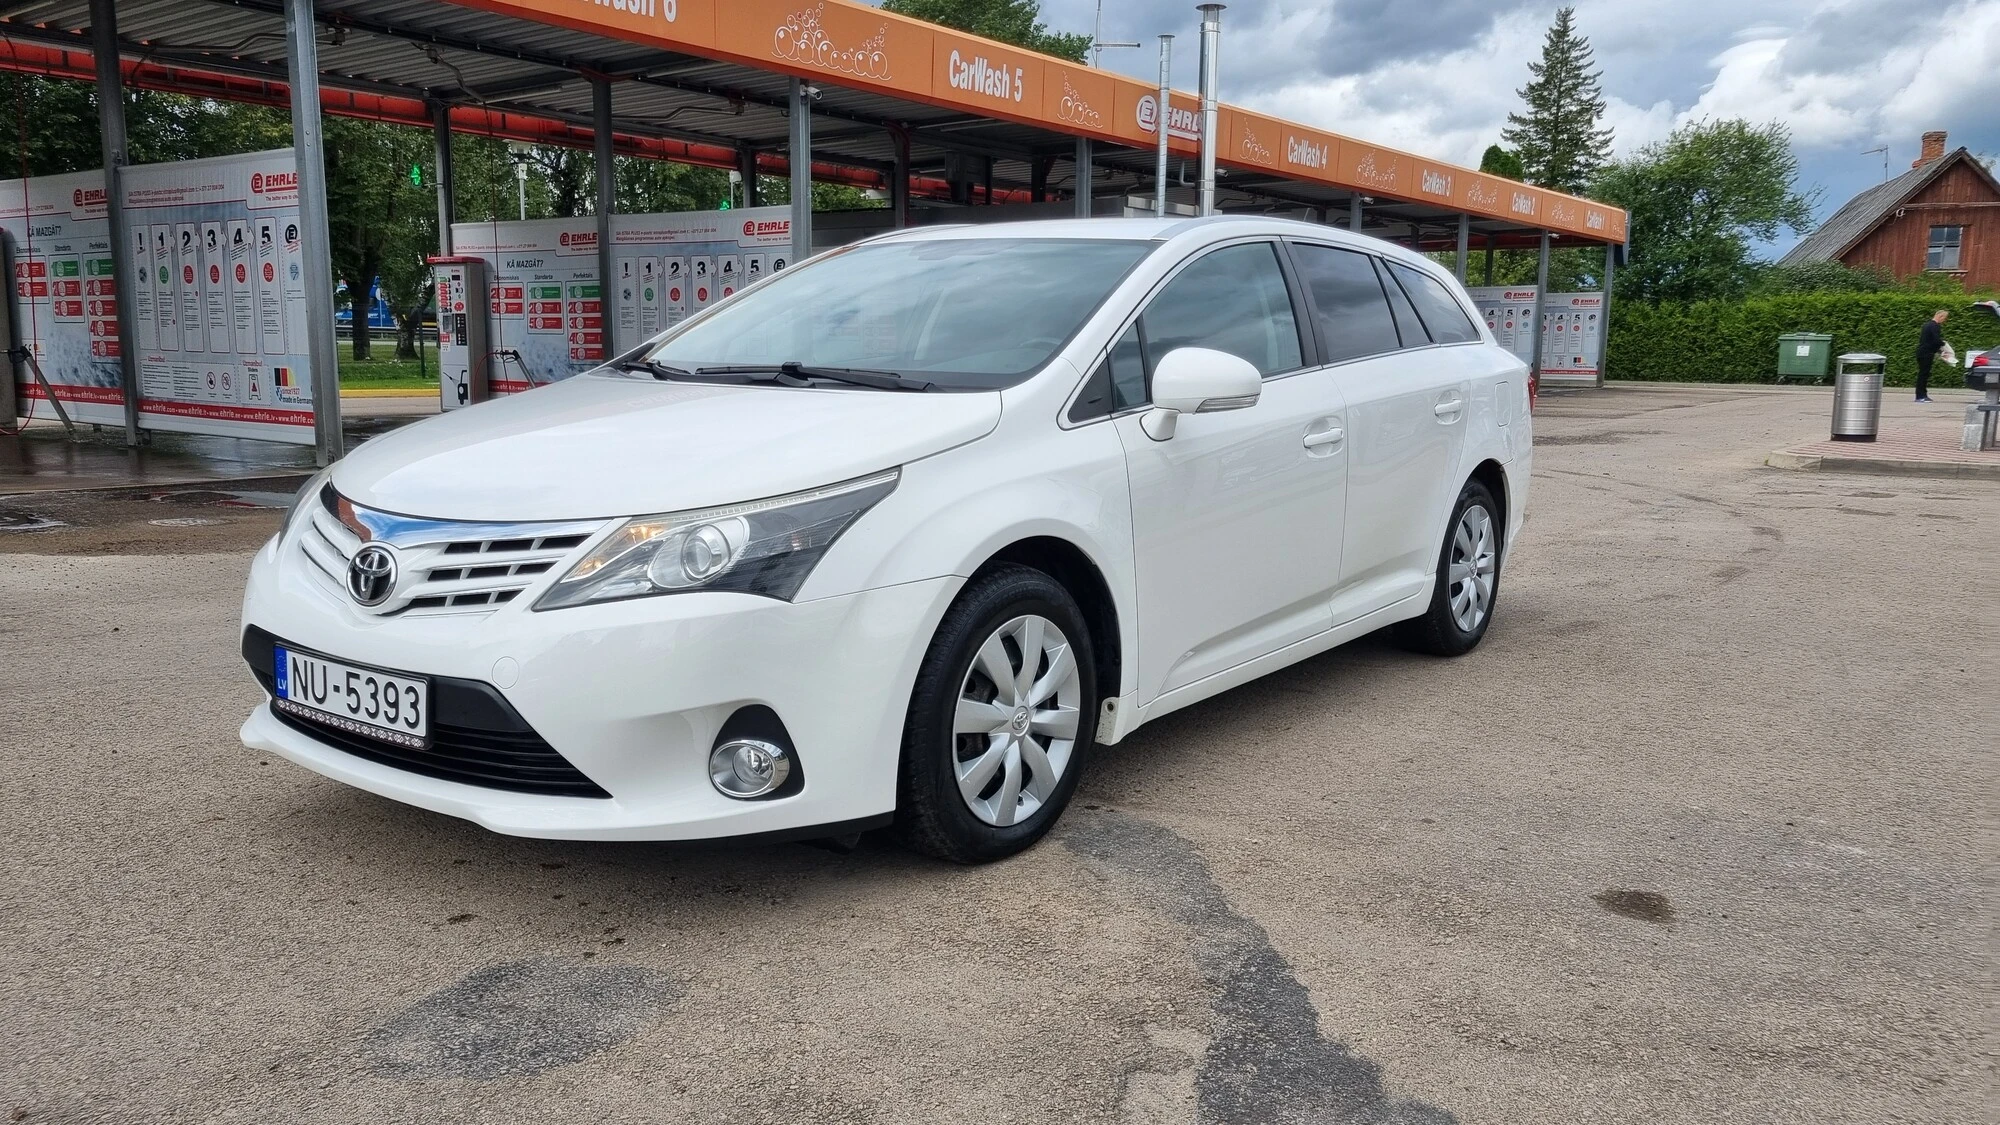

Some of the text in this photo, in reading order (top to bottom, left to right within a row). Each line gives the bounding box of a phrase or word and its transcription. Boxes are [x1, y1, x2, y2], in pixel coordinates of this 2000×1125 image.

[950, 50, 1022, 102] CarWash 5
[1288, 136, 1328, 170] CarWash 4
[266, 172, 298, 187] EHRLE
[1422, 169, 1451, 197] CarWash 3
[1512, 192, 1536, 216] CarWash 2
[757, 220, 790, 231] EHRLE
[1586, 209, 1602, 230] CarWash
[36, 224, 61, 237] MAZGĀT?
[234, 228, 243, 244] 4
[262, 226, 271, 244] 5
[571, 232, 597, 242] EHRLE
[158, 232, 164, 246] 1
[182, 231, 190, 247] 2
[207, 229, 216, 247] 3
[507, 258, 544, 268] KĀ MAZGĀT?
[646, 262, 651, 273] 1
[670, 262, 680, 274] 2
[697, 261, 706, 274] 3
[724, 260, 732, 273] 4
[750, 260, 760, 273] 5
[491, 289, 496, 298] 2
[492, 304, 496, 313] 5
[568, 303, 573, 312] 2
[569, 318, 574, 328] 3
[143, 404, 175, 412] www.ehrle.com
[243, 412, 275, 420] www.ehrle.lv
[278, 414, 313, 424] www.ehrle.co
[277, 678, 287, 690] LV
[292, 656, 420, 729] NU-5393
